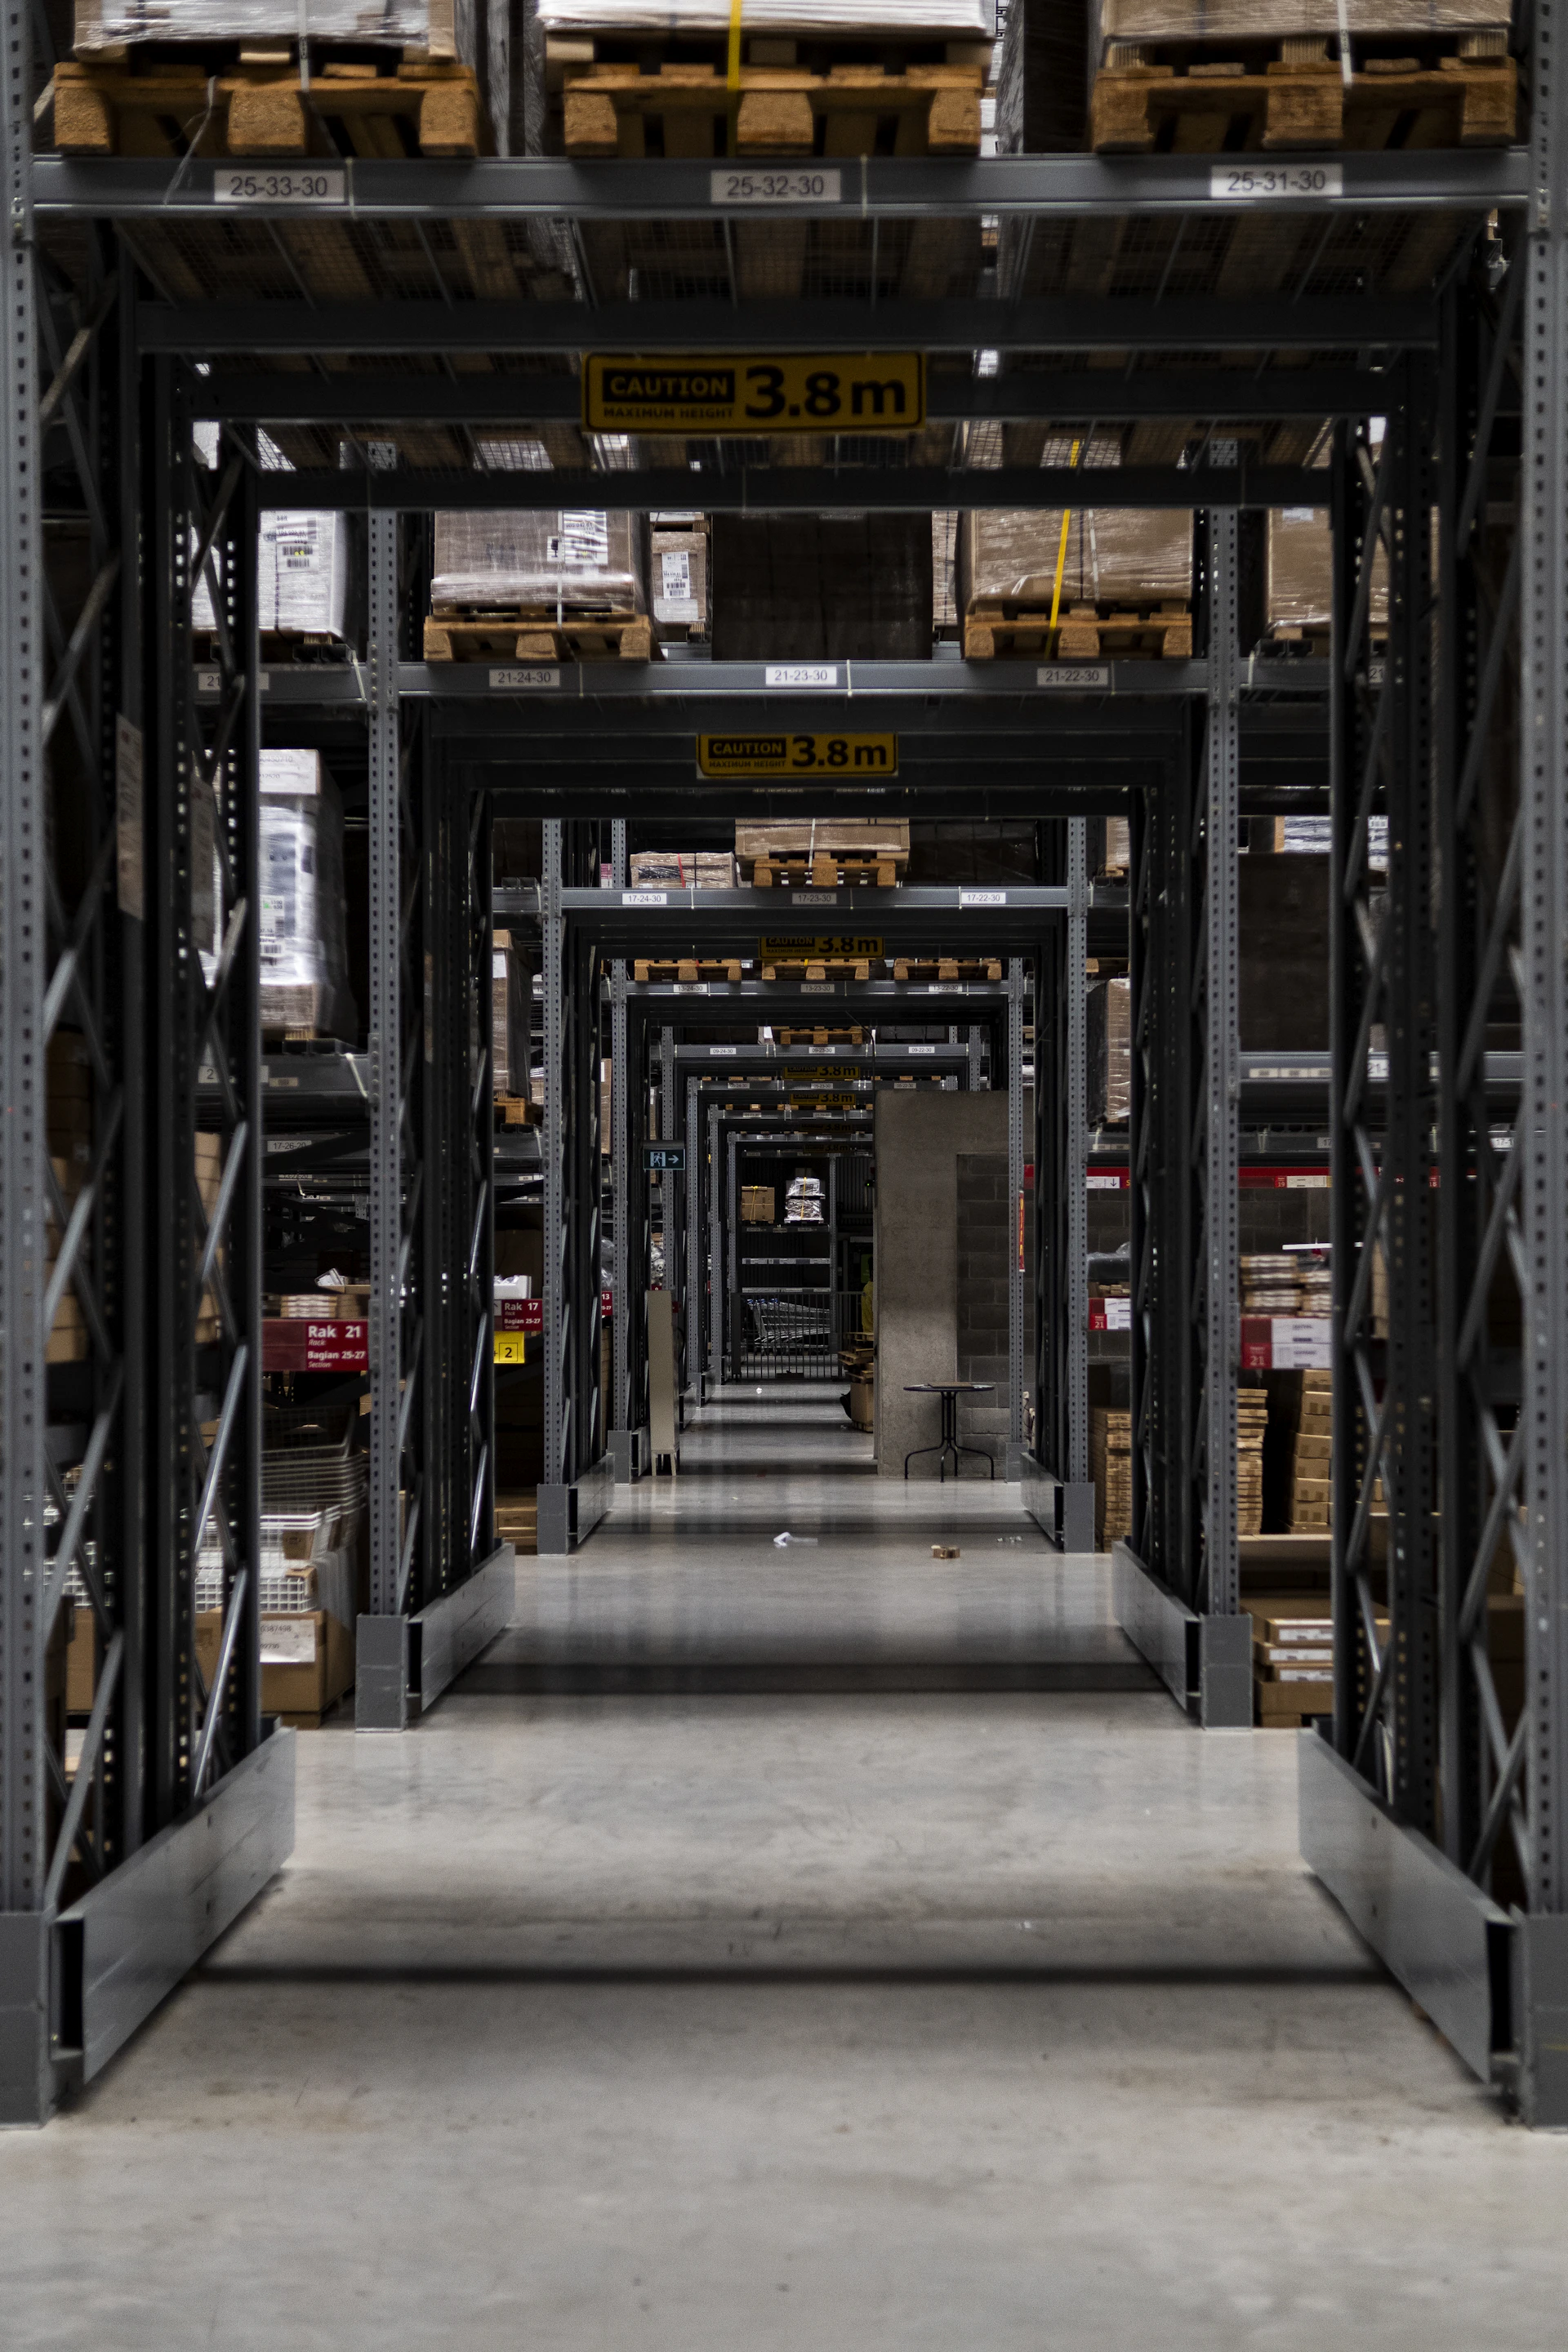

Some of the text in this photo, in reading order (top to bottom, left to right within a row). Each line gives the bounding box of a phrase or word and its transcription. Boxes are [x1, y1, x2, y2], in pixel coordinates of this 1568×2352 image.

[230, 176, 327, 196] 25-33-30
[727, 175, 825, 197] 25-32-30
[1227, 169, 1326, 191] 25-31-30
[609, 375, 728, 397] CAUTION
[603, 407, 733, 419] MAXIMUM HEIGHT
[497, 671, 551, 684] 21-24-30
[774, 669, 828, 681] 21-23-30
[1045, 670, 1100, 682] 21-22-30
[712, 742, 782, 756] CAUTION
[709, 760, 786, 768] MAXIMUM HEIGHT
[799, 894, 831, 902] 17-23-30
[768, 937, 813, 945] CAUTION
[504, 1302, 539, 1311] Rak 17
[308, 1325, 361, 1339] Rak 21
[307, 1351, 366, 1361] Bagian 25-27
[505, 1347, 513, 1358] 2
[308, 1361, 332, 1369] Section
[1250, 1356, 1265, 1366] 21
